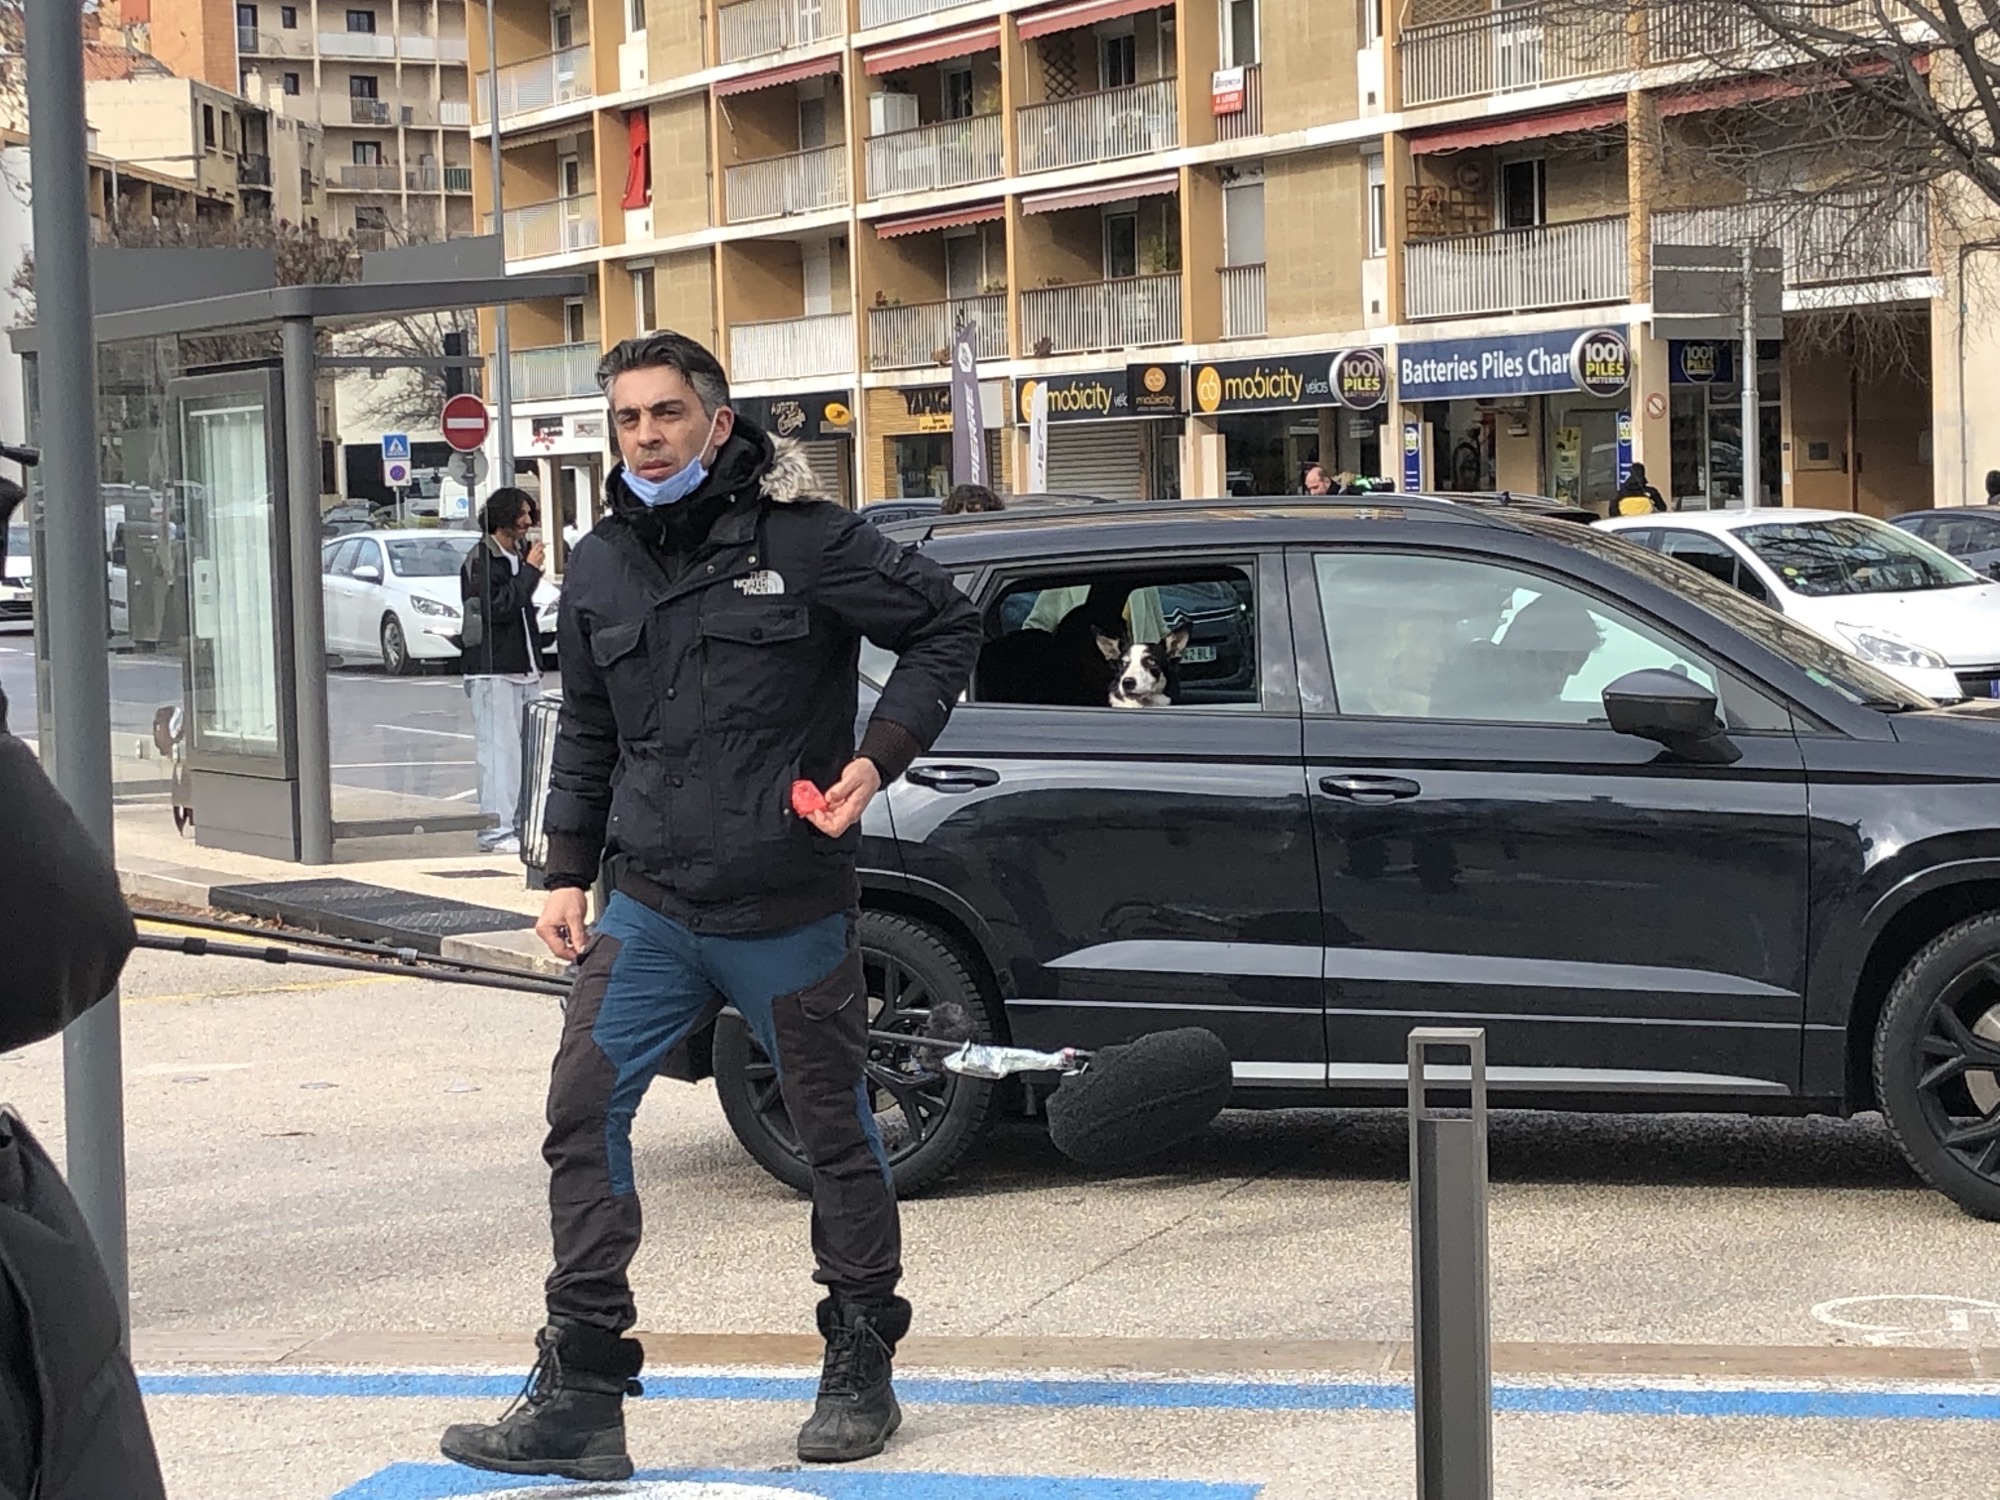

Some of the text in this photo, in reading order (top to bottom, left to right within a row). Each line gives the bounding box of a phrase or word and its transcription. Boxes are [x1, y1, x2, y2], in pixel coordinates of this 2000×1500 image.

[1585, 342, 1624, 362] 1001
[1686, 345, 1714, 359] 1001
[1342, 360, 1381, 378] 1001
[1402, 353, 1478, 385] Batteries
[1481, 350, 1524, 379] Piles
[1585, 362, 1625, 376] PILES
[1225, 366, 1303, 402] mobicity
[1343, 378, 1381, 391] PILES
[1047, 380, 1112, 415] mobicity
[750, 571, 768, 579] THE
[733, 579, 768, 588] NORTH
[743, 587, 768, 595] FACE
